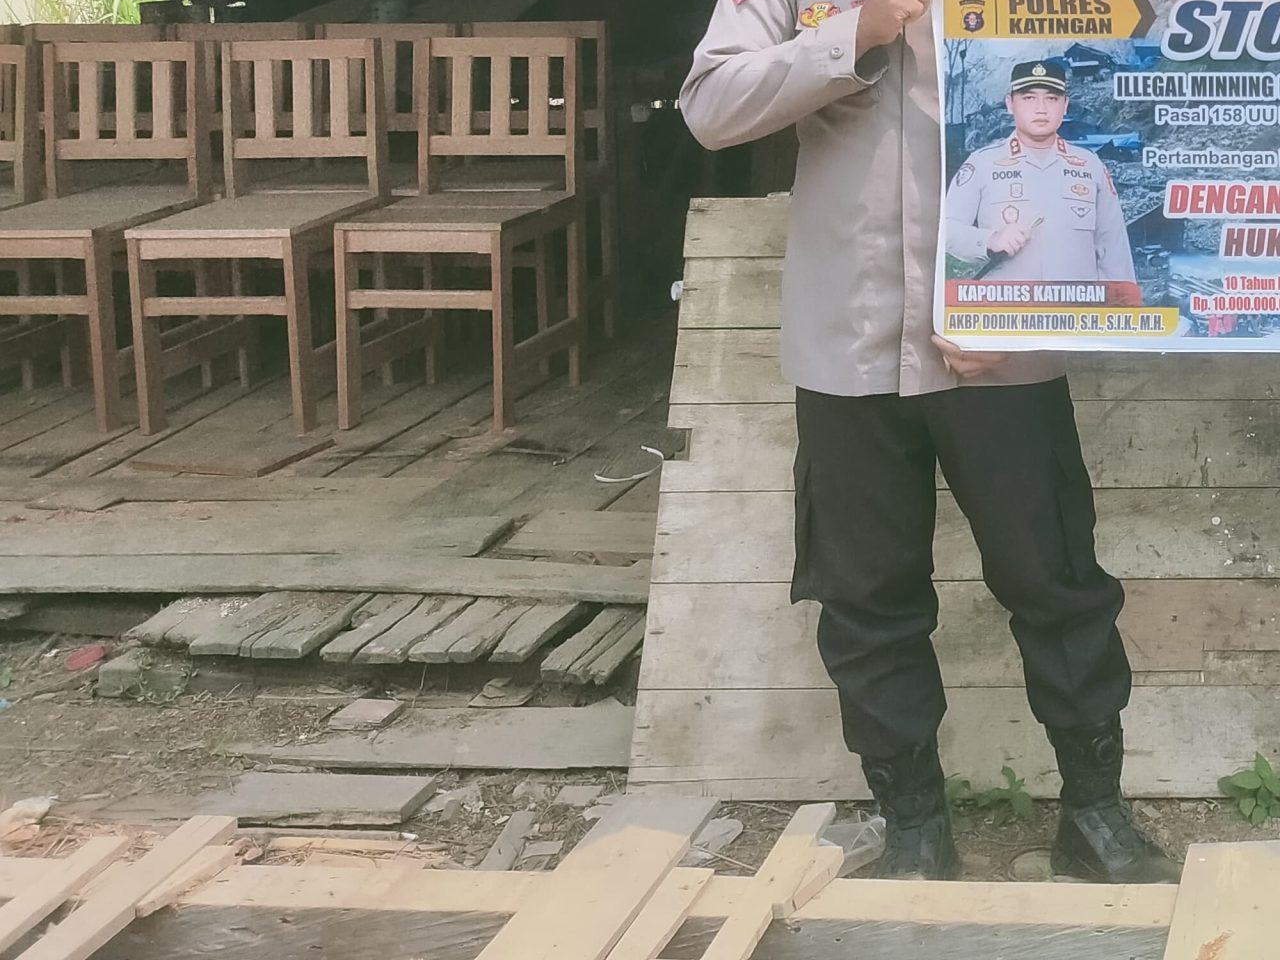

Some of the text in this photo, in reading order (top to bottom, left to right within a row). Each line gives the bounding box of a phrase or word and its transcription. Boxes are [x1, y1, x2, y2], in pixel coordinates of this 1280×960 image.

[1008, 17, 1113, 35] KATINGAN
[1116, 75, 1187, 98] ILLEGAL
[1190, 75, 1275, 98] MINNING
[1158, 107, 1206, 123] Pasal
[1211, 107, 1243, 123] 158
[1248, 107, 1275, 123] UU
[1145, 150, 1275, 167] Pertambangan
[991, 170, 1023, 181] DODIK
[1062, 168, 1093, 180] POLRI
[1224, 276, 1239, 290] 10
[1240, 276, 1276, 291] Tahun
[957, 284, 1106, 304] KAPOLRES KATINGAN
[1193, 296, 1211, 313] Rp.
[948, 313, 981, 331] AKBP
[982, 313, 1020, 331] DODIK
[1021, 313, 1078, 333] HARTONO,
[1139, 314, 1165, 331] M.H.
